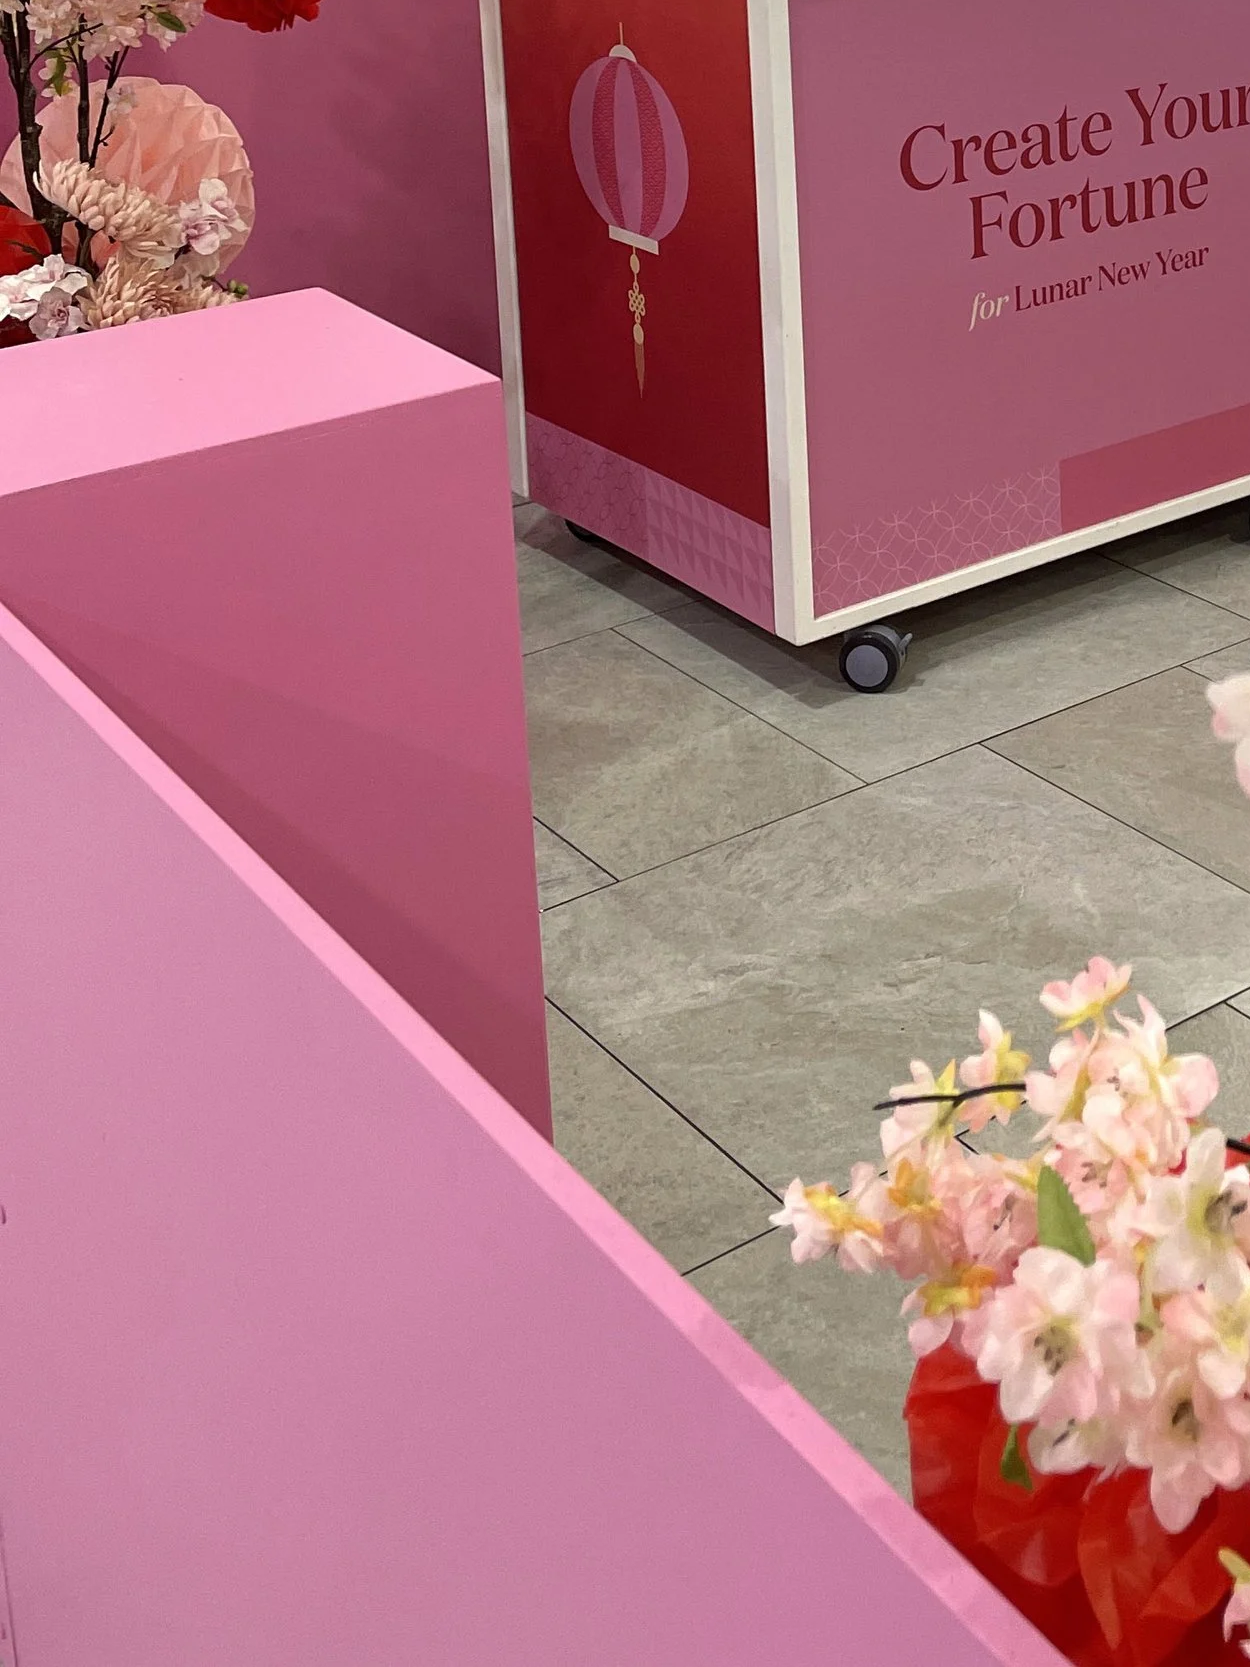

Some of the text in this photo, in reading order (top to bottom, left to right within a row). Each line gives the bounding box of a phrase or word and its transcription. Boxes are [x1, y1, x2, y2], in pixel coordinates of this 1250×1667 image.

[900, 104, 1112, 191] Create
[969, 167, 1209, 260] Fortune
[968, 246, 1210, 332] for Lunar New Year
